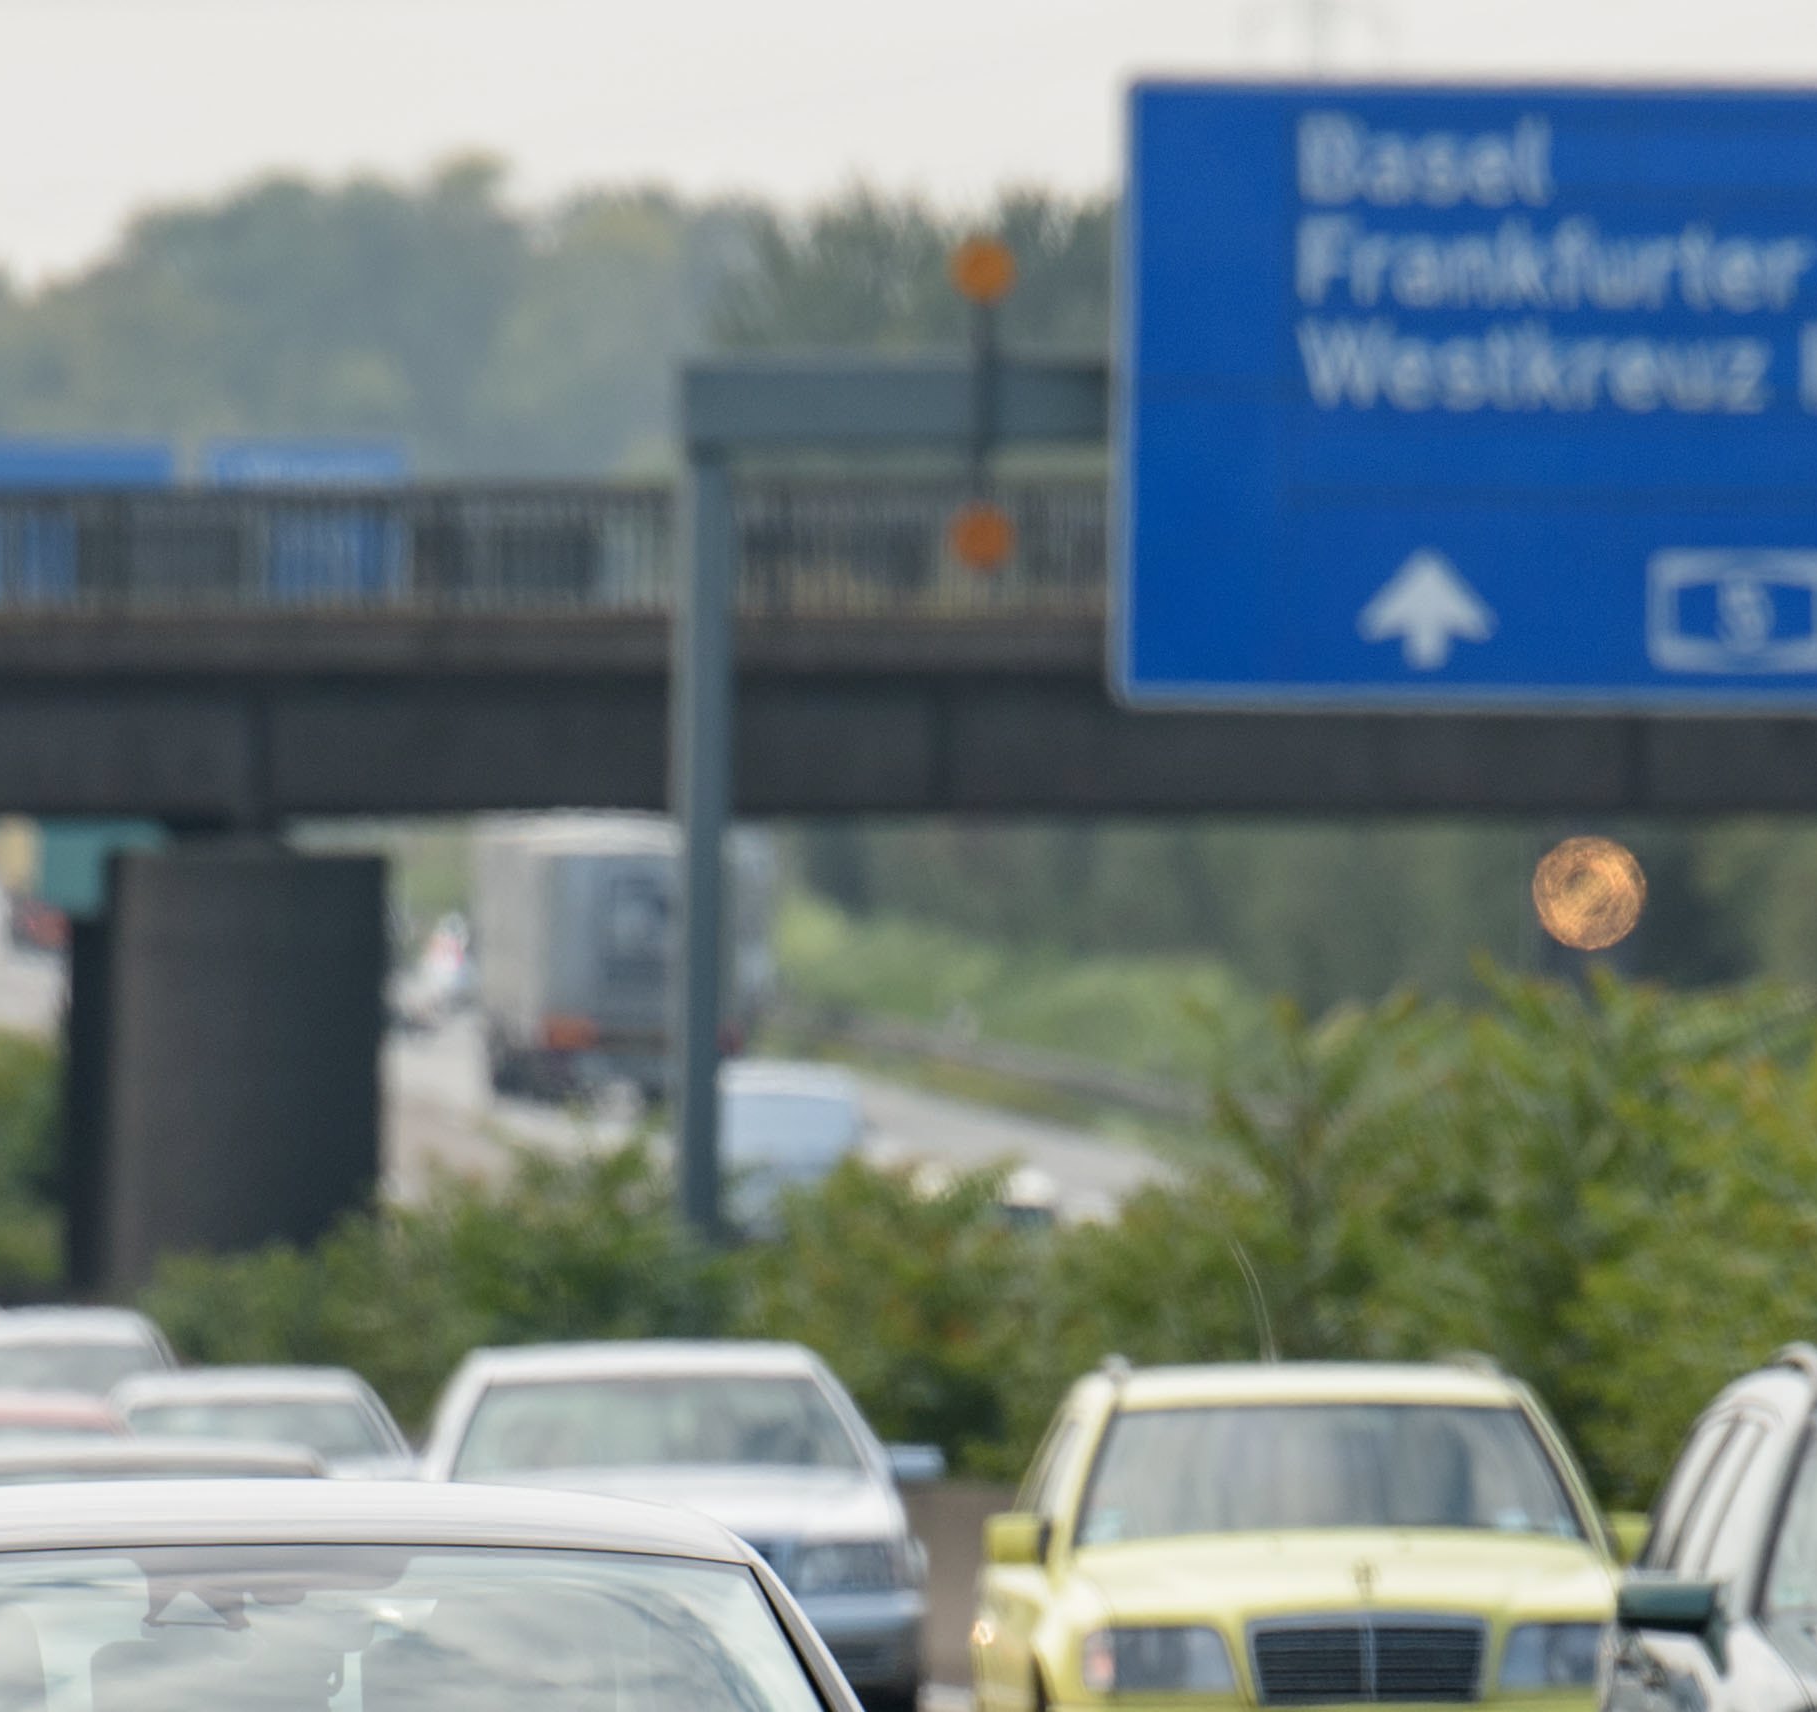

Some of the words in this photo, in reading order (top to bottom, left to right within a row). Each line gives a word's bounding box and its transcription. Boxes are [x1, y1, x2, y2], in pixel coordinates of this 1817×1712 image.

[1297, 112, 1551, 205] Basel
[1297, 214, 1815, 312] Frankfurter
[1298, 318, 1773, 414] Westkreuz
[1717, 568, 1774, 653] 5
